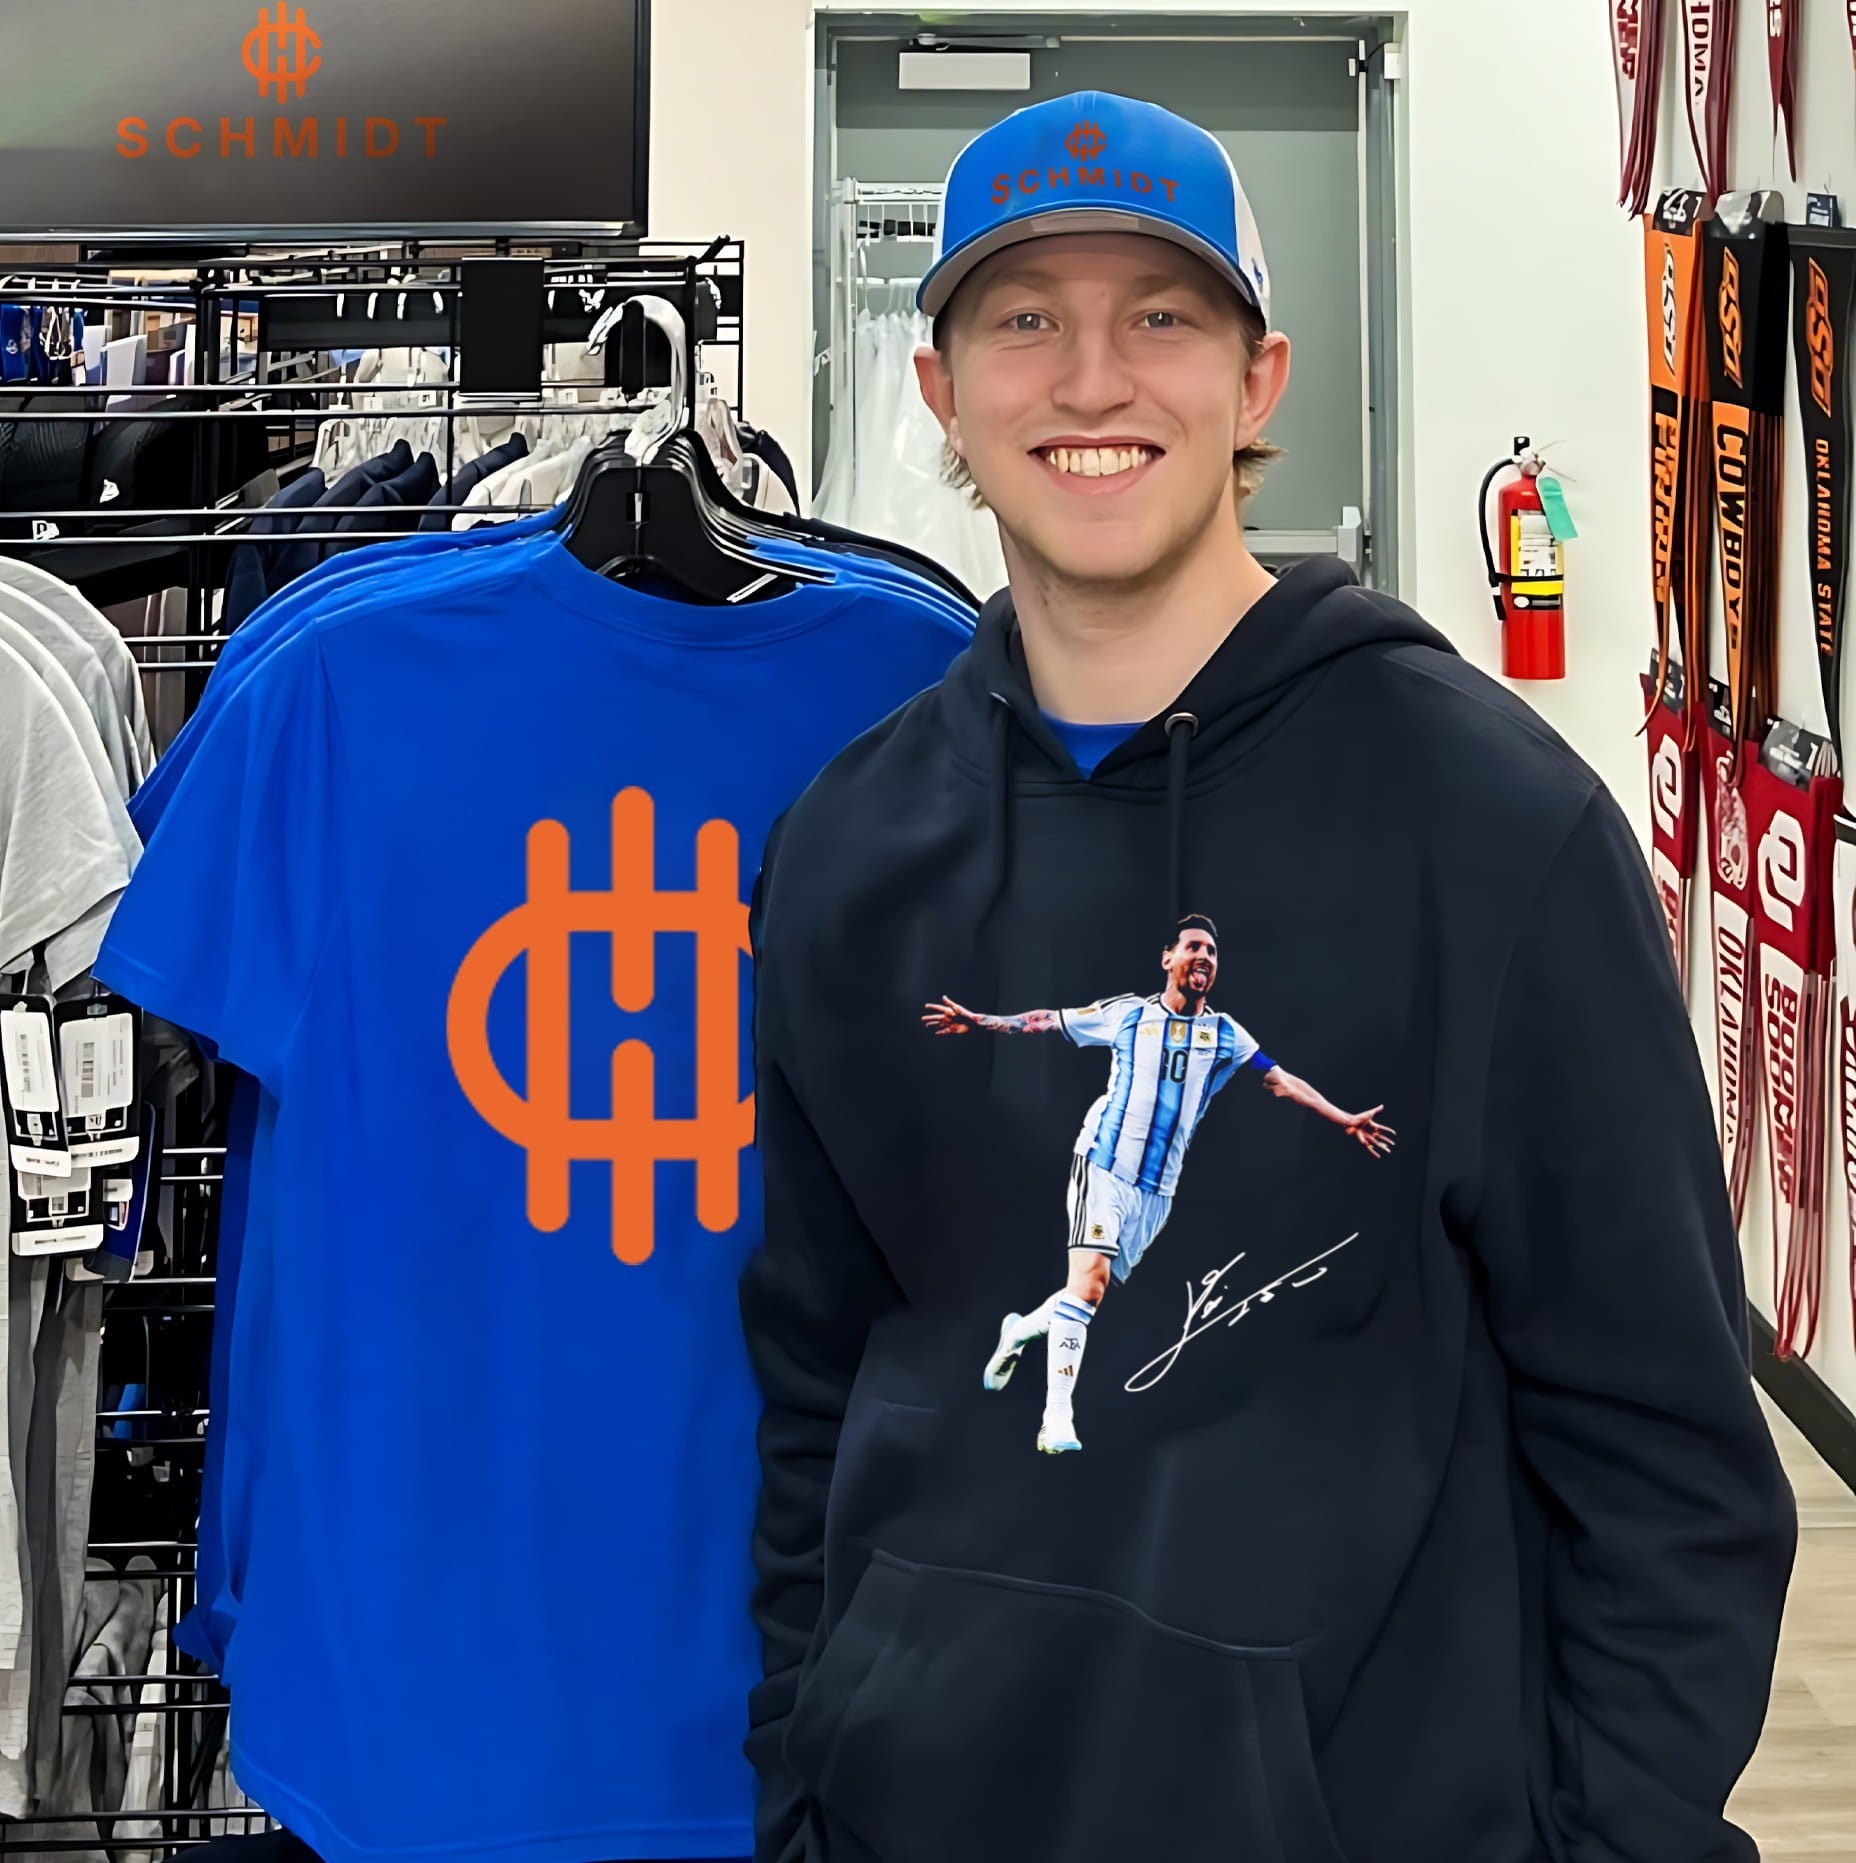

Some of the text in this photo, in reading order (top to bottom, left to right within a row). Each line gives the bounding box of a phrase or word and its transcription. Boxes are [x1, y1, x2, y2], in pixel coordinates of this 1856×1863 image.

[116, 117, 447, 158] SCHMIDT
[991, 167, 1179, 205] SCHMIDT
[1815, 438, 1833, 570] OKLAHOMA
[1718, 926, 1745, 1144] OKLAHOMA
